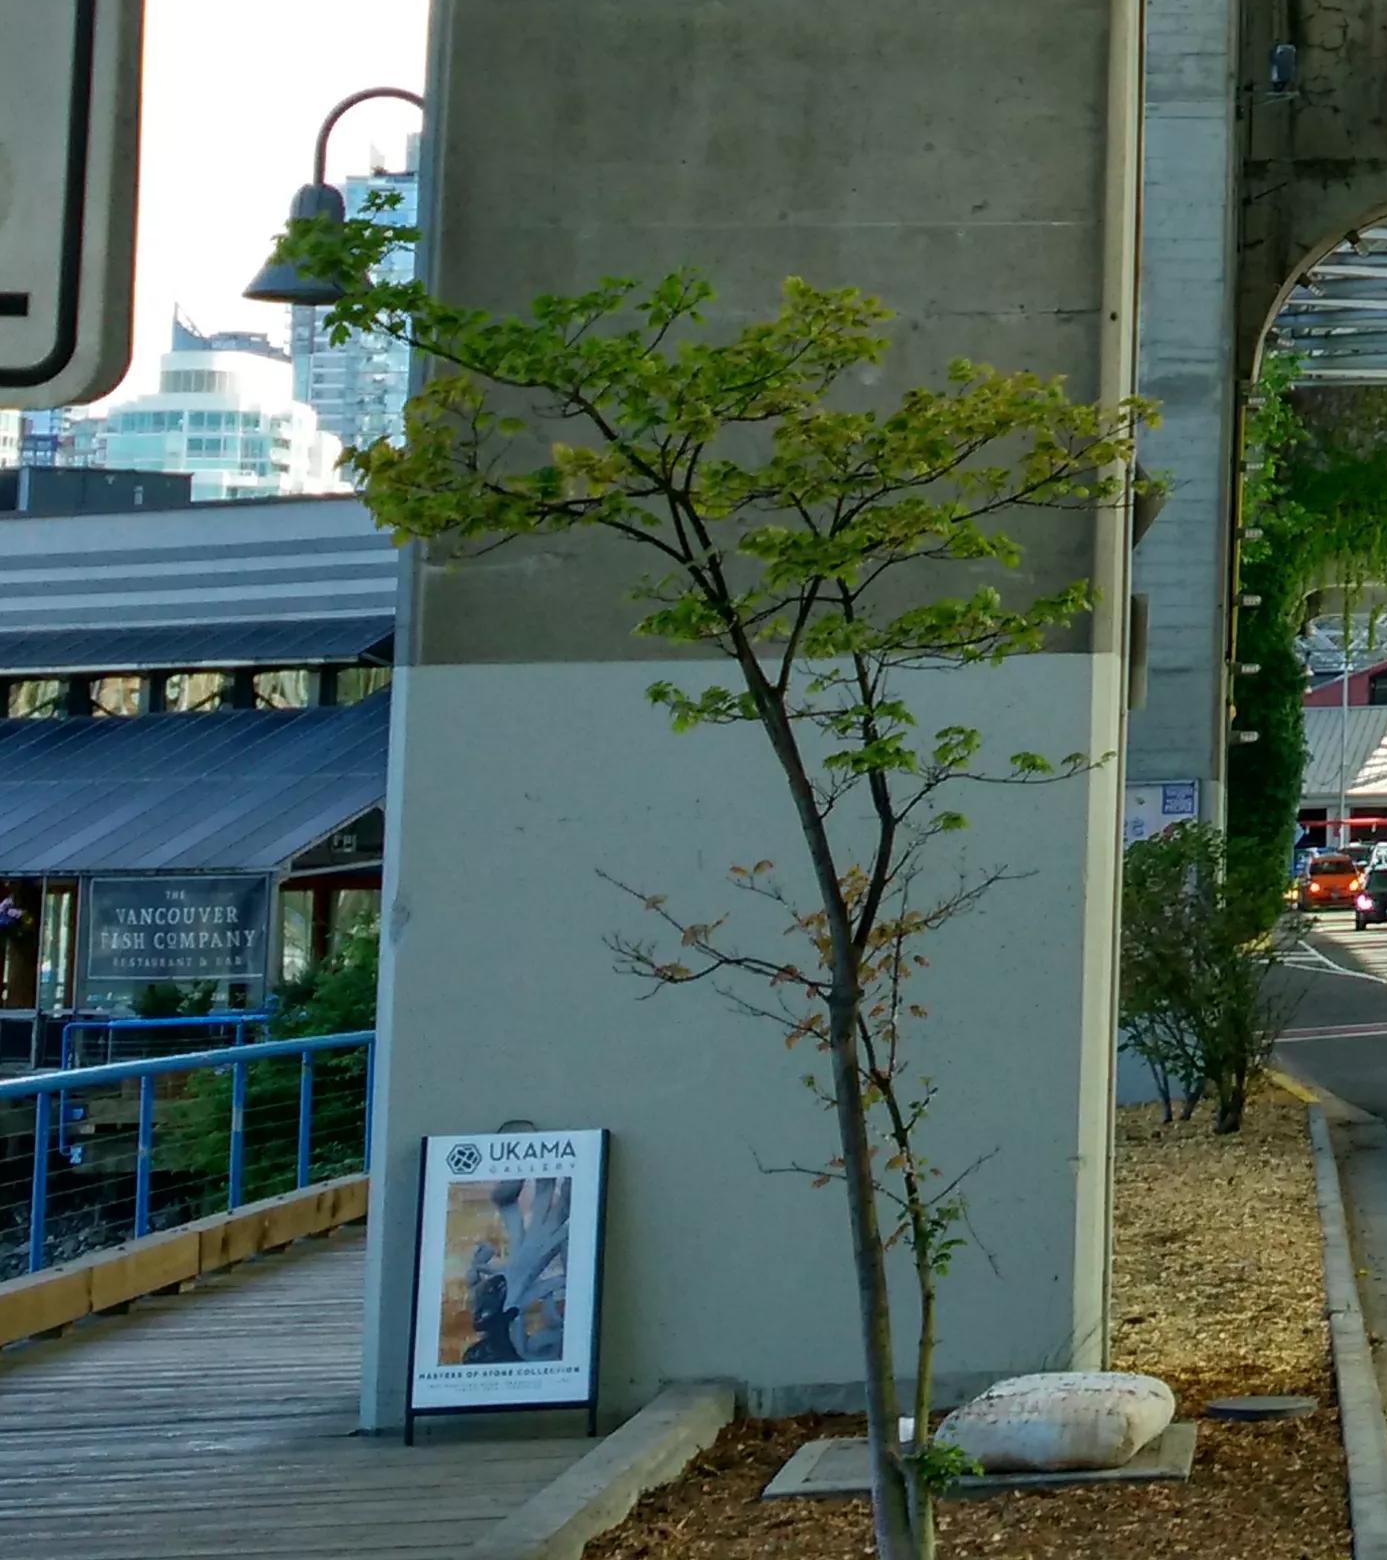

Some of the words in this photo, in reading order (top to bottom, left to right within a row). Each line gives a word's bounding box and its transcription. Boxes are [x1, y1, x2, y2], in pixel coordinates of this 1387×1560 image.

[165, 890, 185, 900] THE
[116, 906, 238, 925] VANCOUVER
[101, 932, 145, 950] FISH
[153, 930, 256, 950] COMPANY
[489, 1140, 576, 1162] UKAMA
